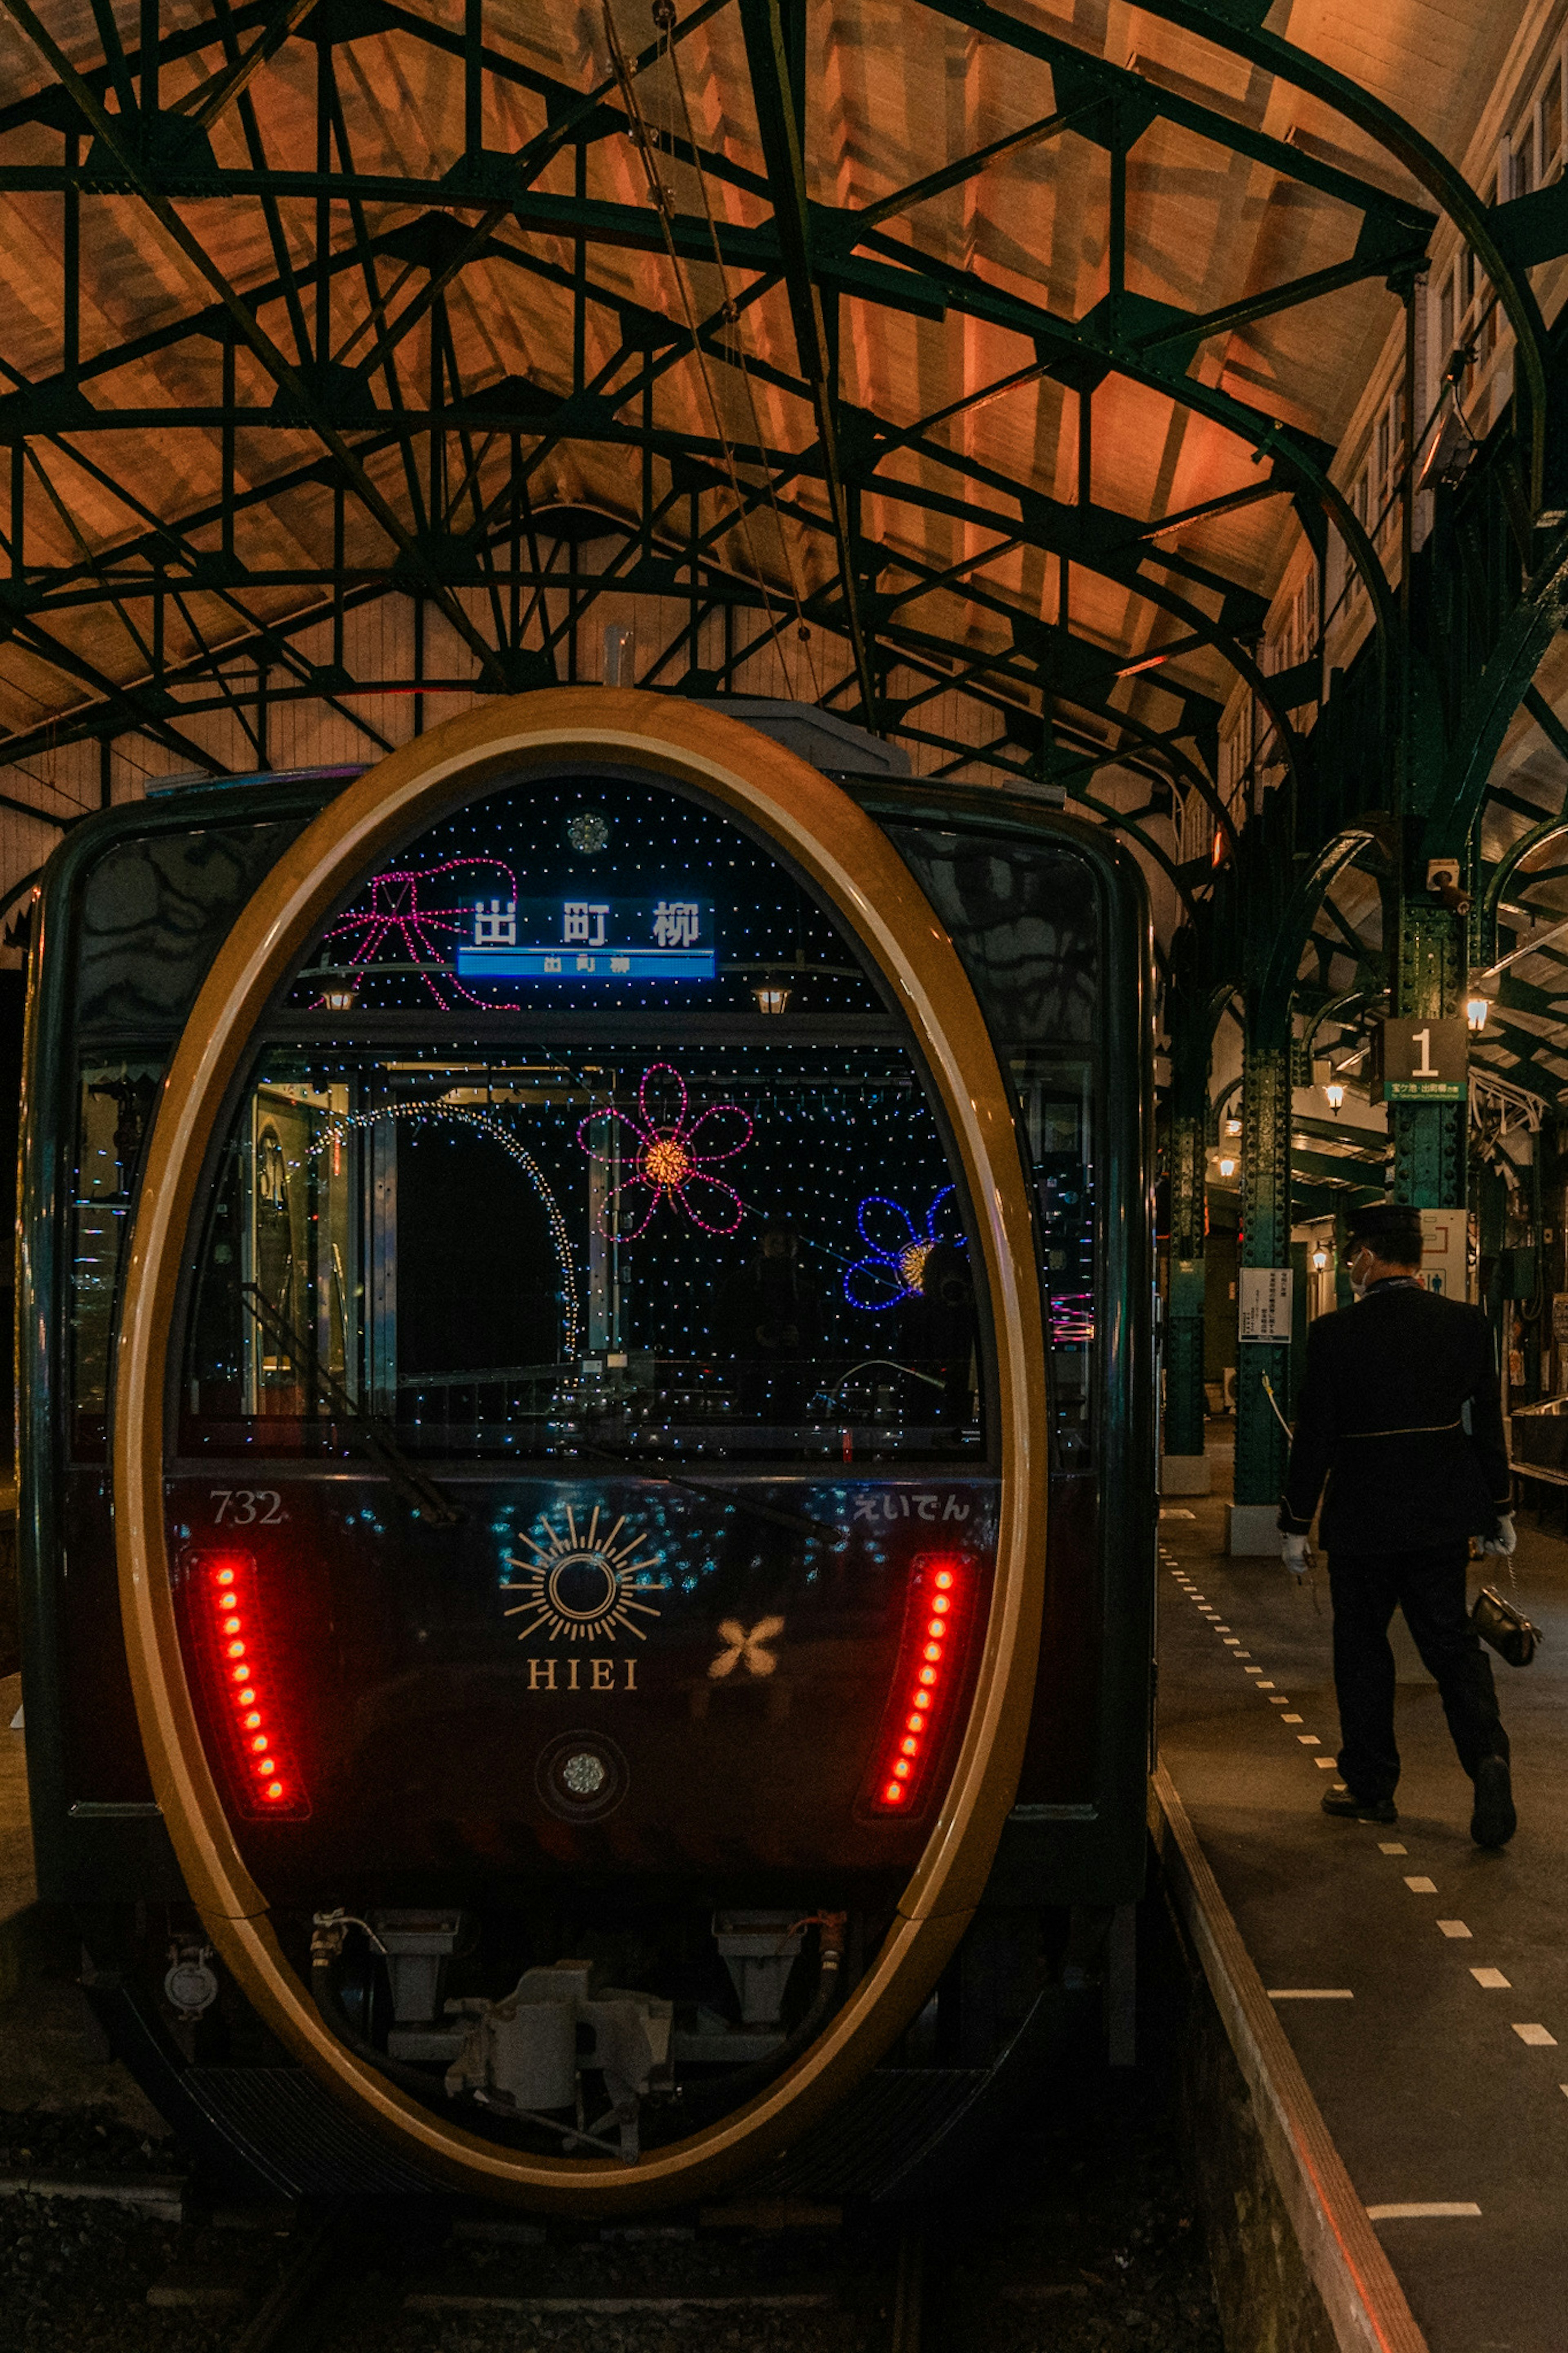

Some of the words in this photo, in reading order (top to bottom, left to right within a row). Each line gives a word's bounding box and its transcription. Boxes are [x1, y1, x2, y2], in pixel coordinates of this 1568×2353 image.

[475, 899, 699, 948] 出町柳
[1412, 1028, 1439, 1077] 1
[209, 1490, 283, 1524] 732
[854, 1494, 970, 1521] えいでん
[527, 1659, 638, 1690] HIEI
